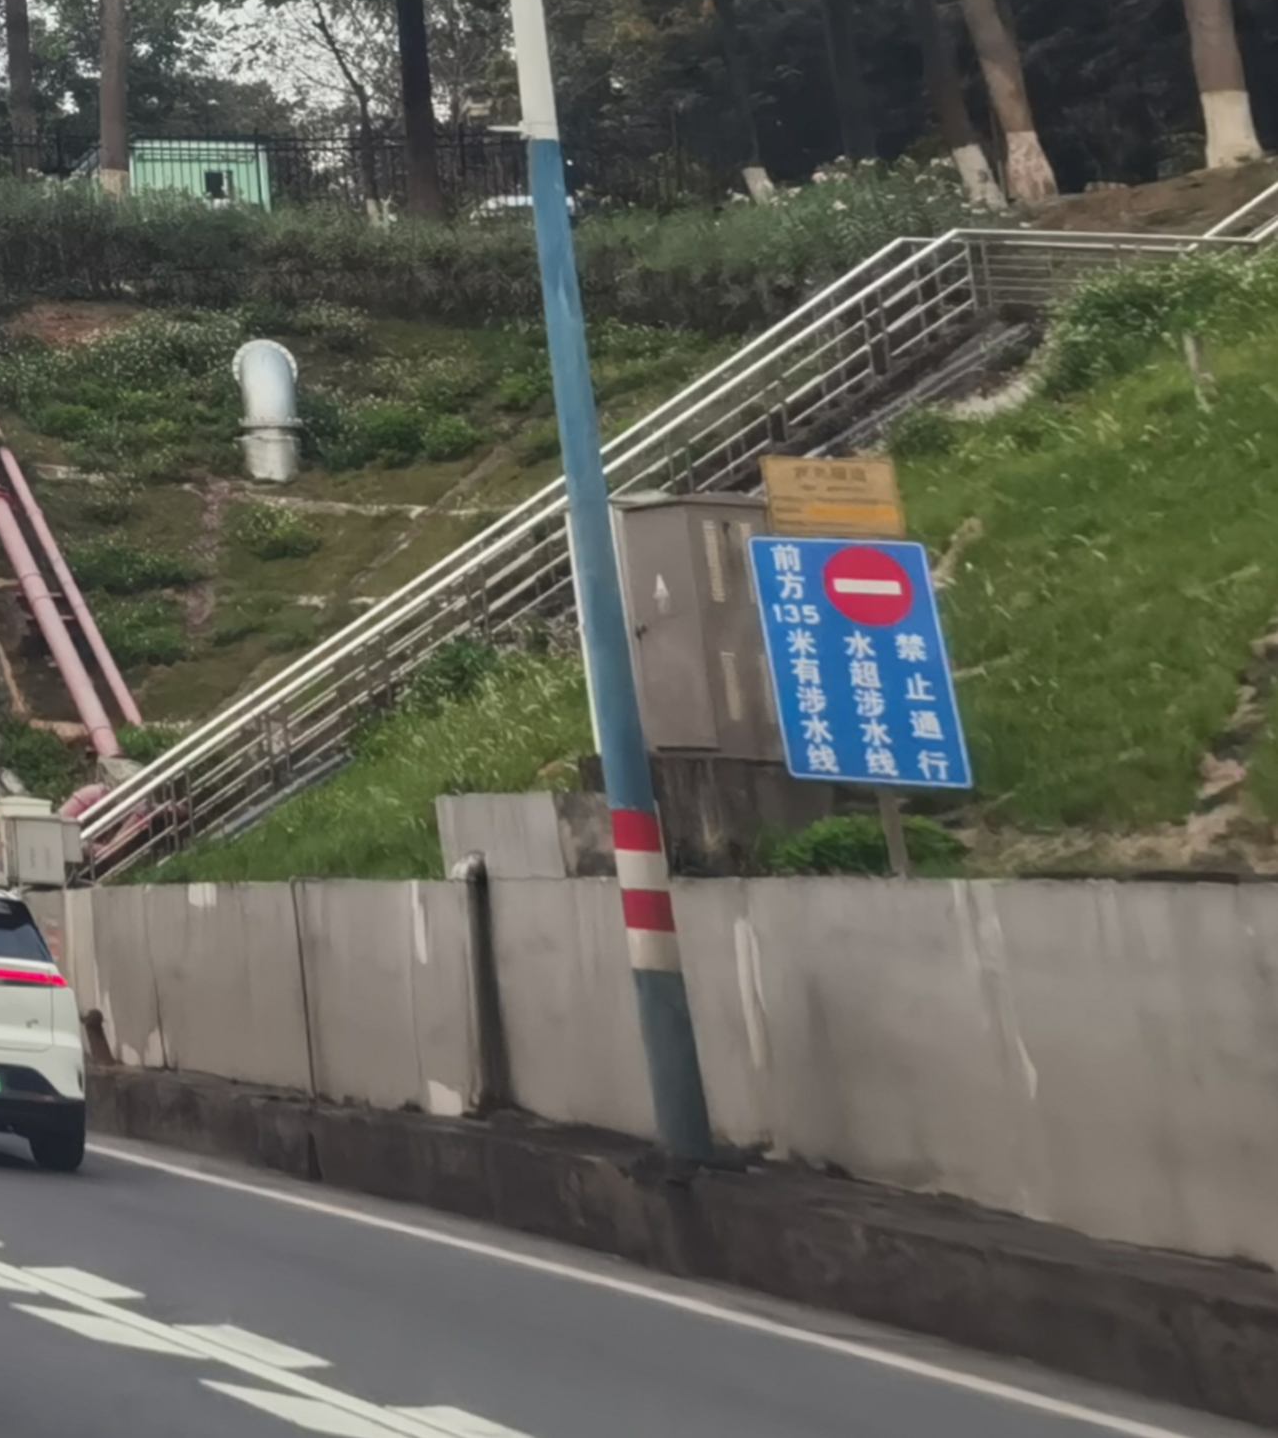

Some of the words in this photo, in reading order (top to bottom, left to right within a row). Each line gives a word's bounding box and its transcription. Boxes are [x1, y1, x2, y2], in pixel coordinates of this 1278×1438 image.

[769, 543, 841, 774] 前方135米有涉水线
[843, 630, 900, 778] 水超涉水线
[894, 632, 950, 781] 禁止通行
